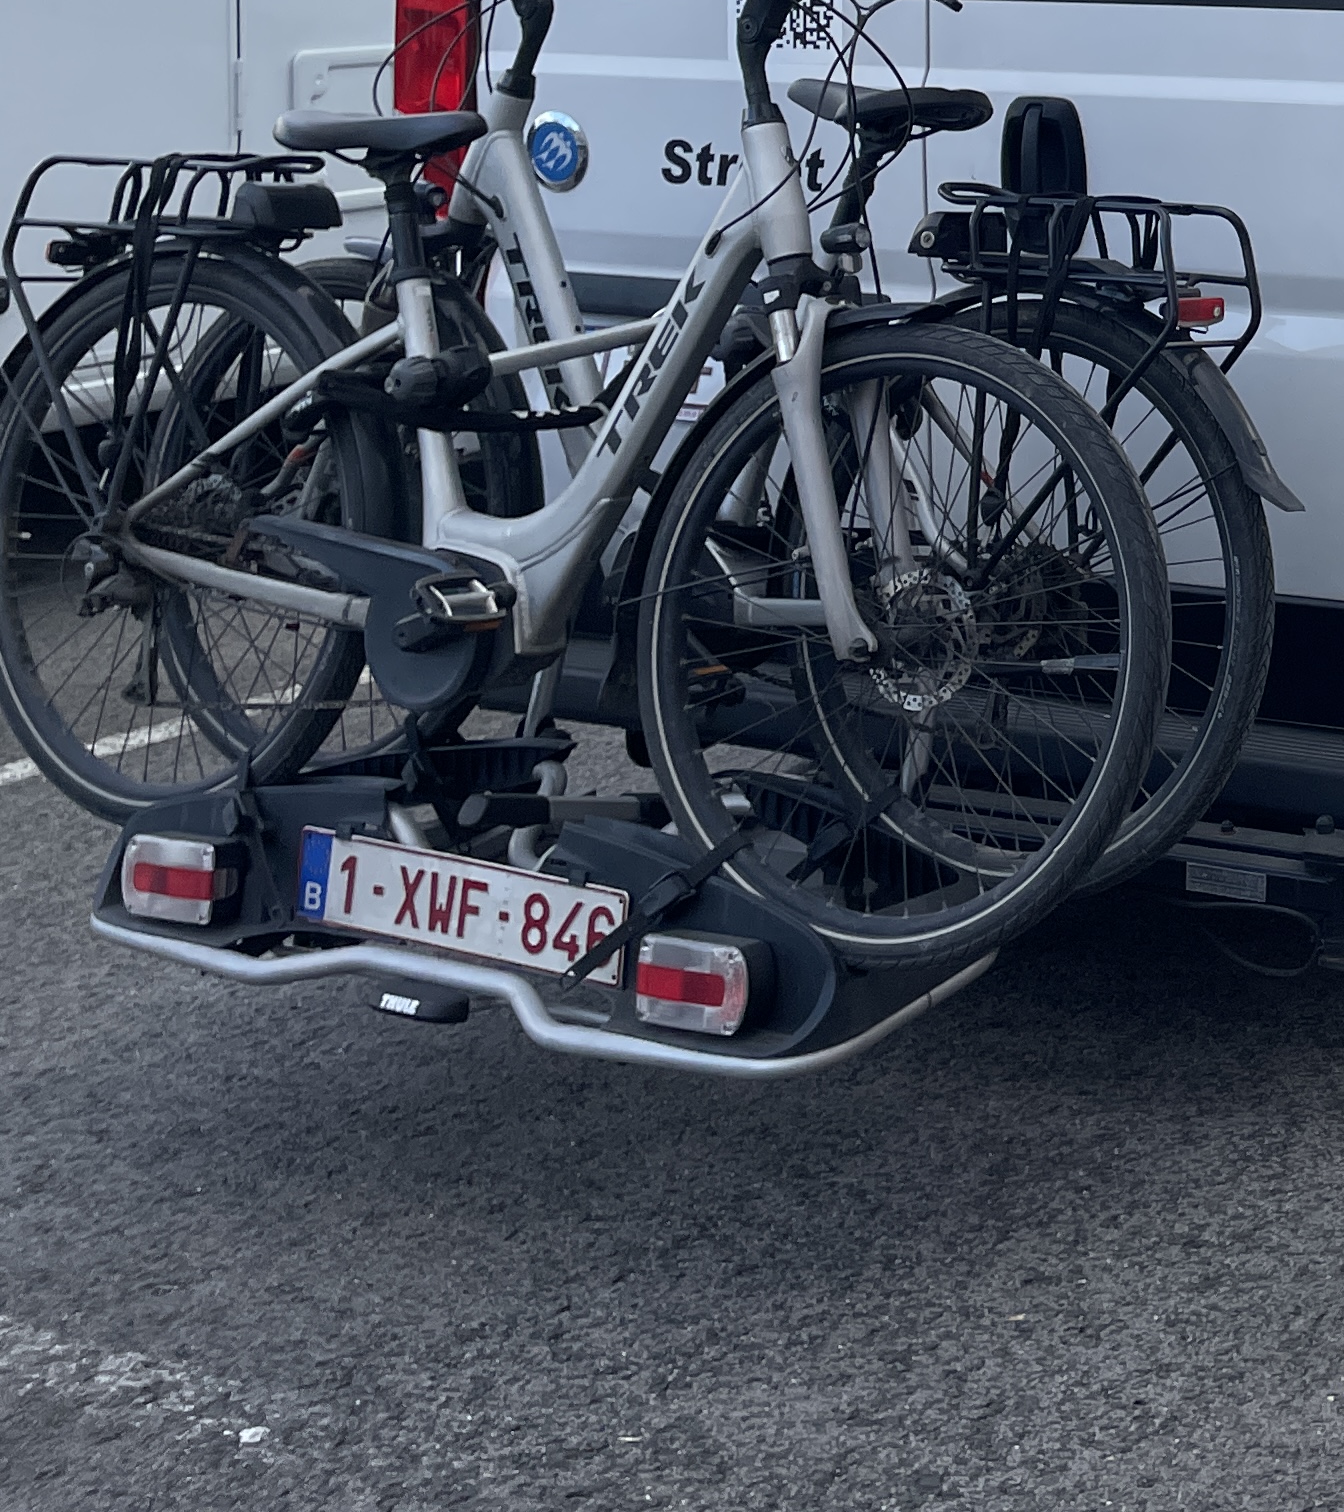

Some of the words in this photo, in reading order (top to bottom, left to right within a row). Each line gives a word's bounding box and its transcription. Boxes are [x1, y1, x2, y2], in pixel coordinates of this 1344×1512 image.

[661, 139, 825, 192] Strt
[596, 264, 706, 458] TREK
[304, 881, 322, 910] B
[380, 993, 421, 1016] THULE
